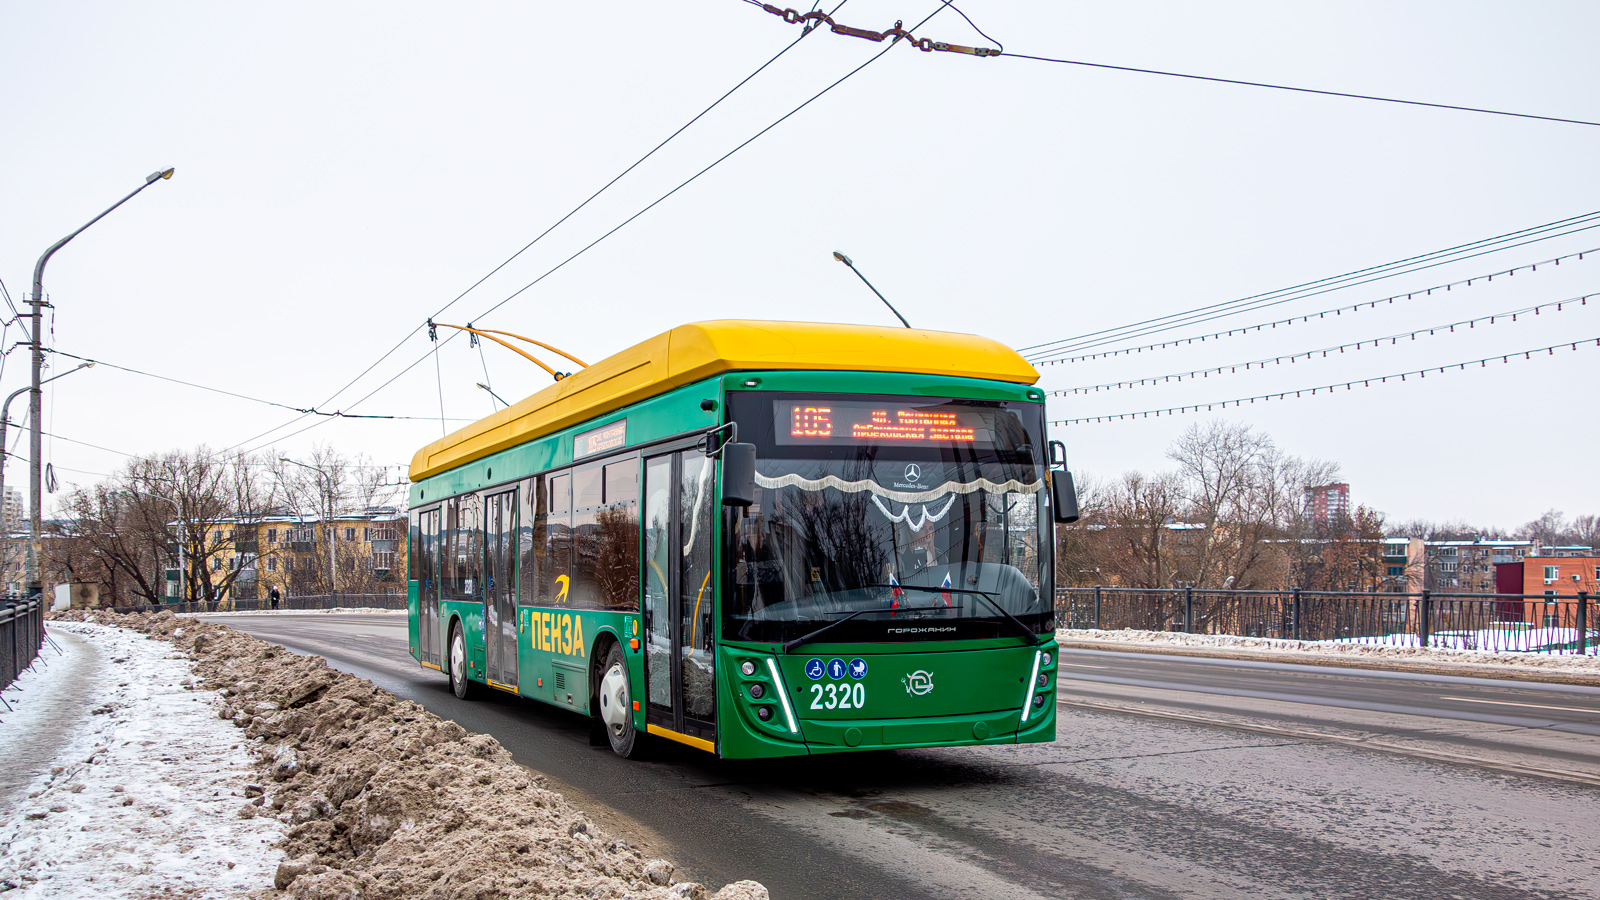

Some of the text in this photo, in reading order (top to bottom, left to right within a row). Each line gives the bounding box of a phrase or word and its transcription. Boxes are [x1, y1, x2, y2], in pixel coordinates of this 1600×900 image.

[791, 406, 831, 436] 105
[893, 482, 929, 490] Mercedes-Benz
[531, 611, 585, 658] ПЕНЗА
[887, 626, 957, 634] ГОРОЖАНИН
[809, 682, 865, 710] 2320
